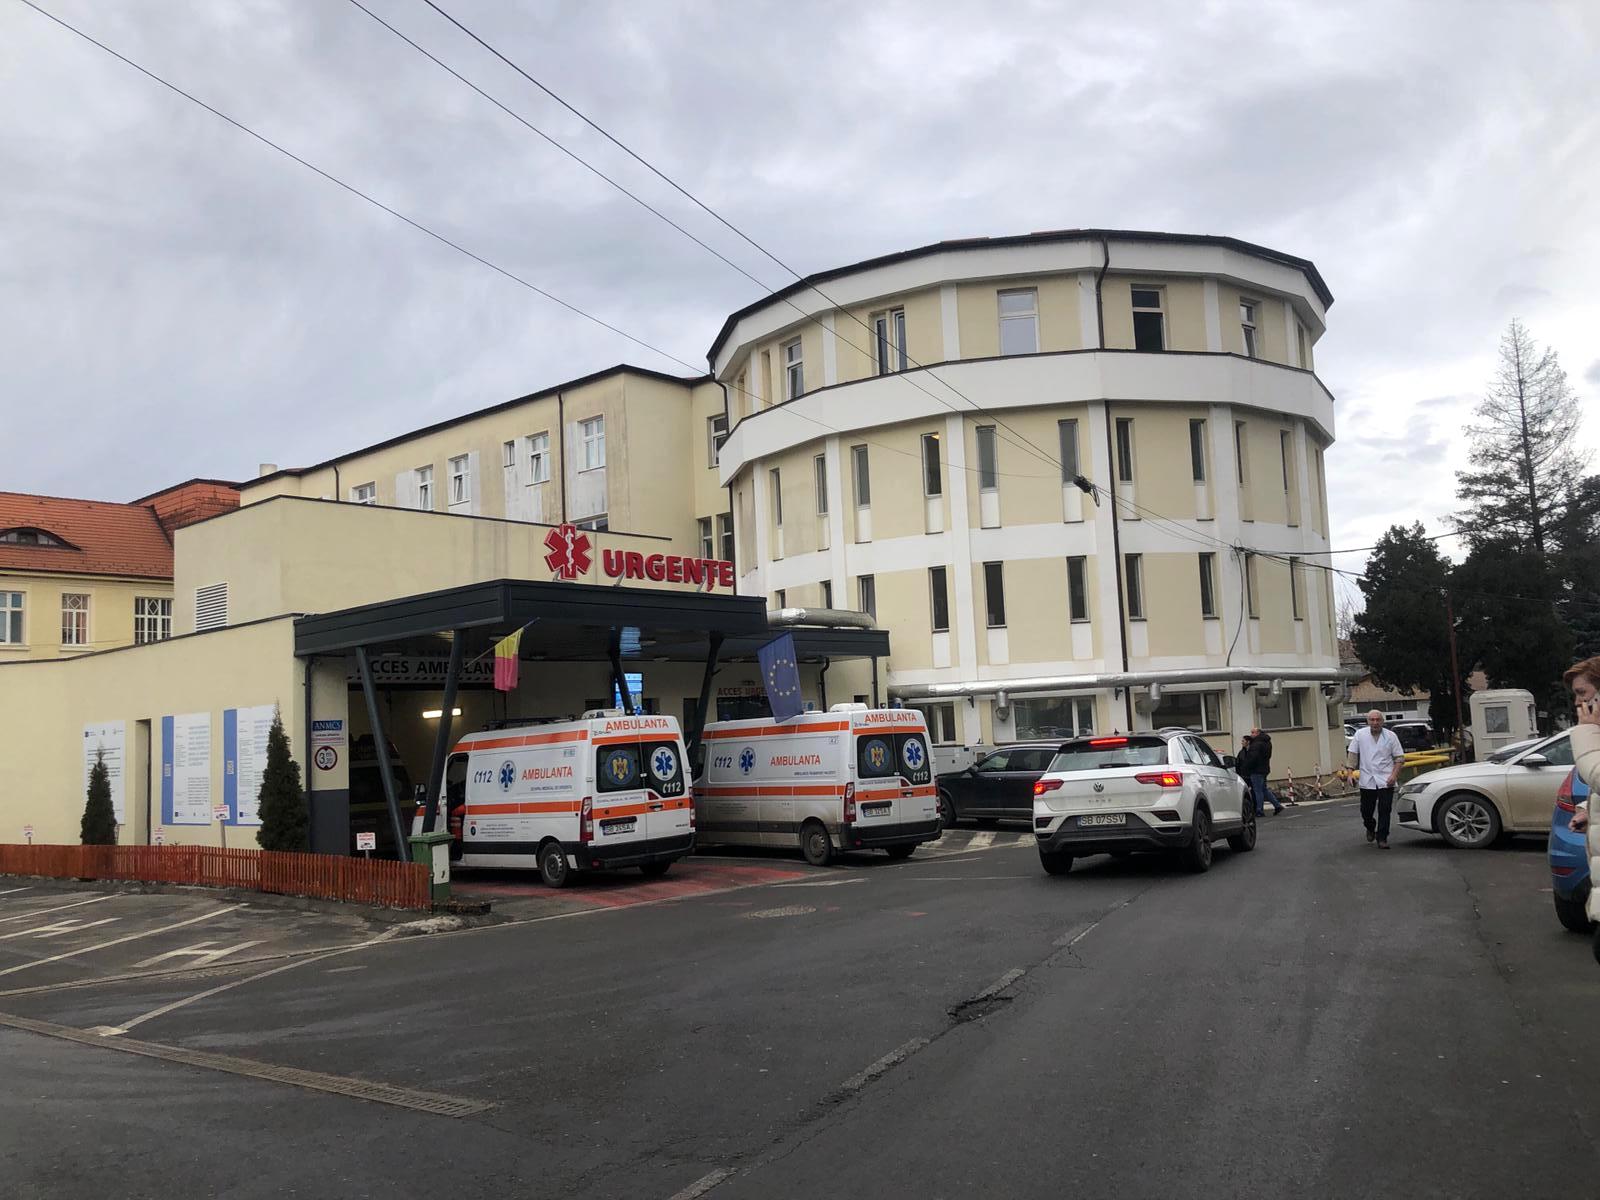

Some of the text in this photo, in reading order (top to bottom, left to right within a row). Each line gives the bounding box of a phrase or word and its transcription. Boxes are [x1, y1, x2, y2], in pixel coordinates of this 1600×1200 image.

[357, 660, 409, 674] CCES
[864, 712, 917, 723] AMBULANTA
[605, 718, 669, 732] AMBULANTA
[770, 754, 821, 767] AMBULANTA
[522, 766, 573, 780] AMBULANTA
[1081, 815, 1124, 825] SB 07SSV
